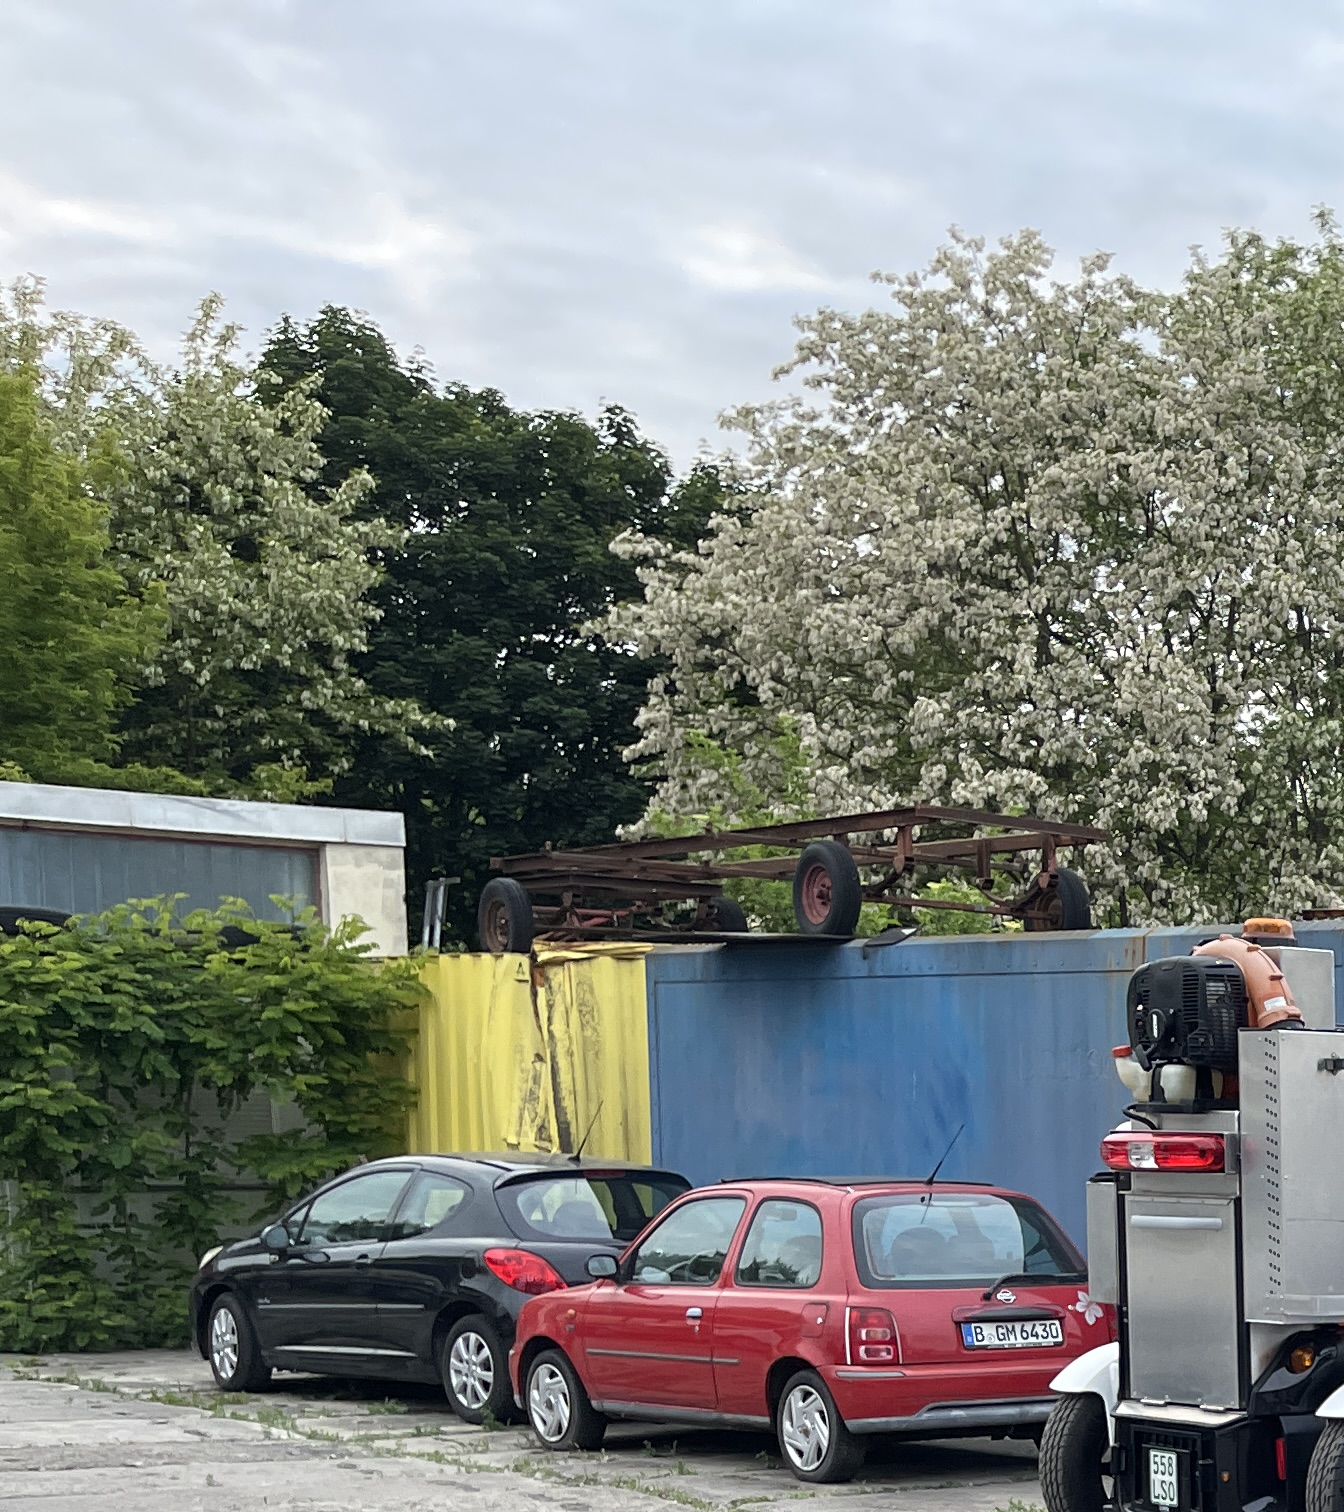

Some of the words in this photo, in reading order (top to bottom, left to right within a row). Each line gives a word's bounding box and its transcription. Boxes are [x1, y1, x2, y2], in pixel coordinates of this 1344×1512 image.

[973, 1325, 985, 1342] B
[996, 1323, 1017, 1341] GM
[1020, 1322, 1059, 1340] 6430
[1152, 1453, 1174, 1477] 558
